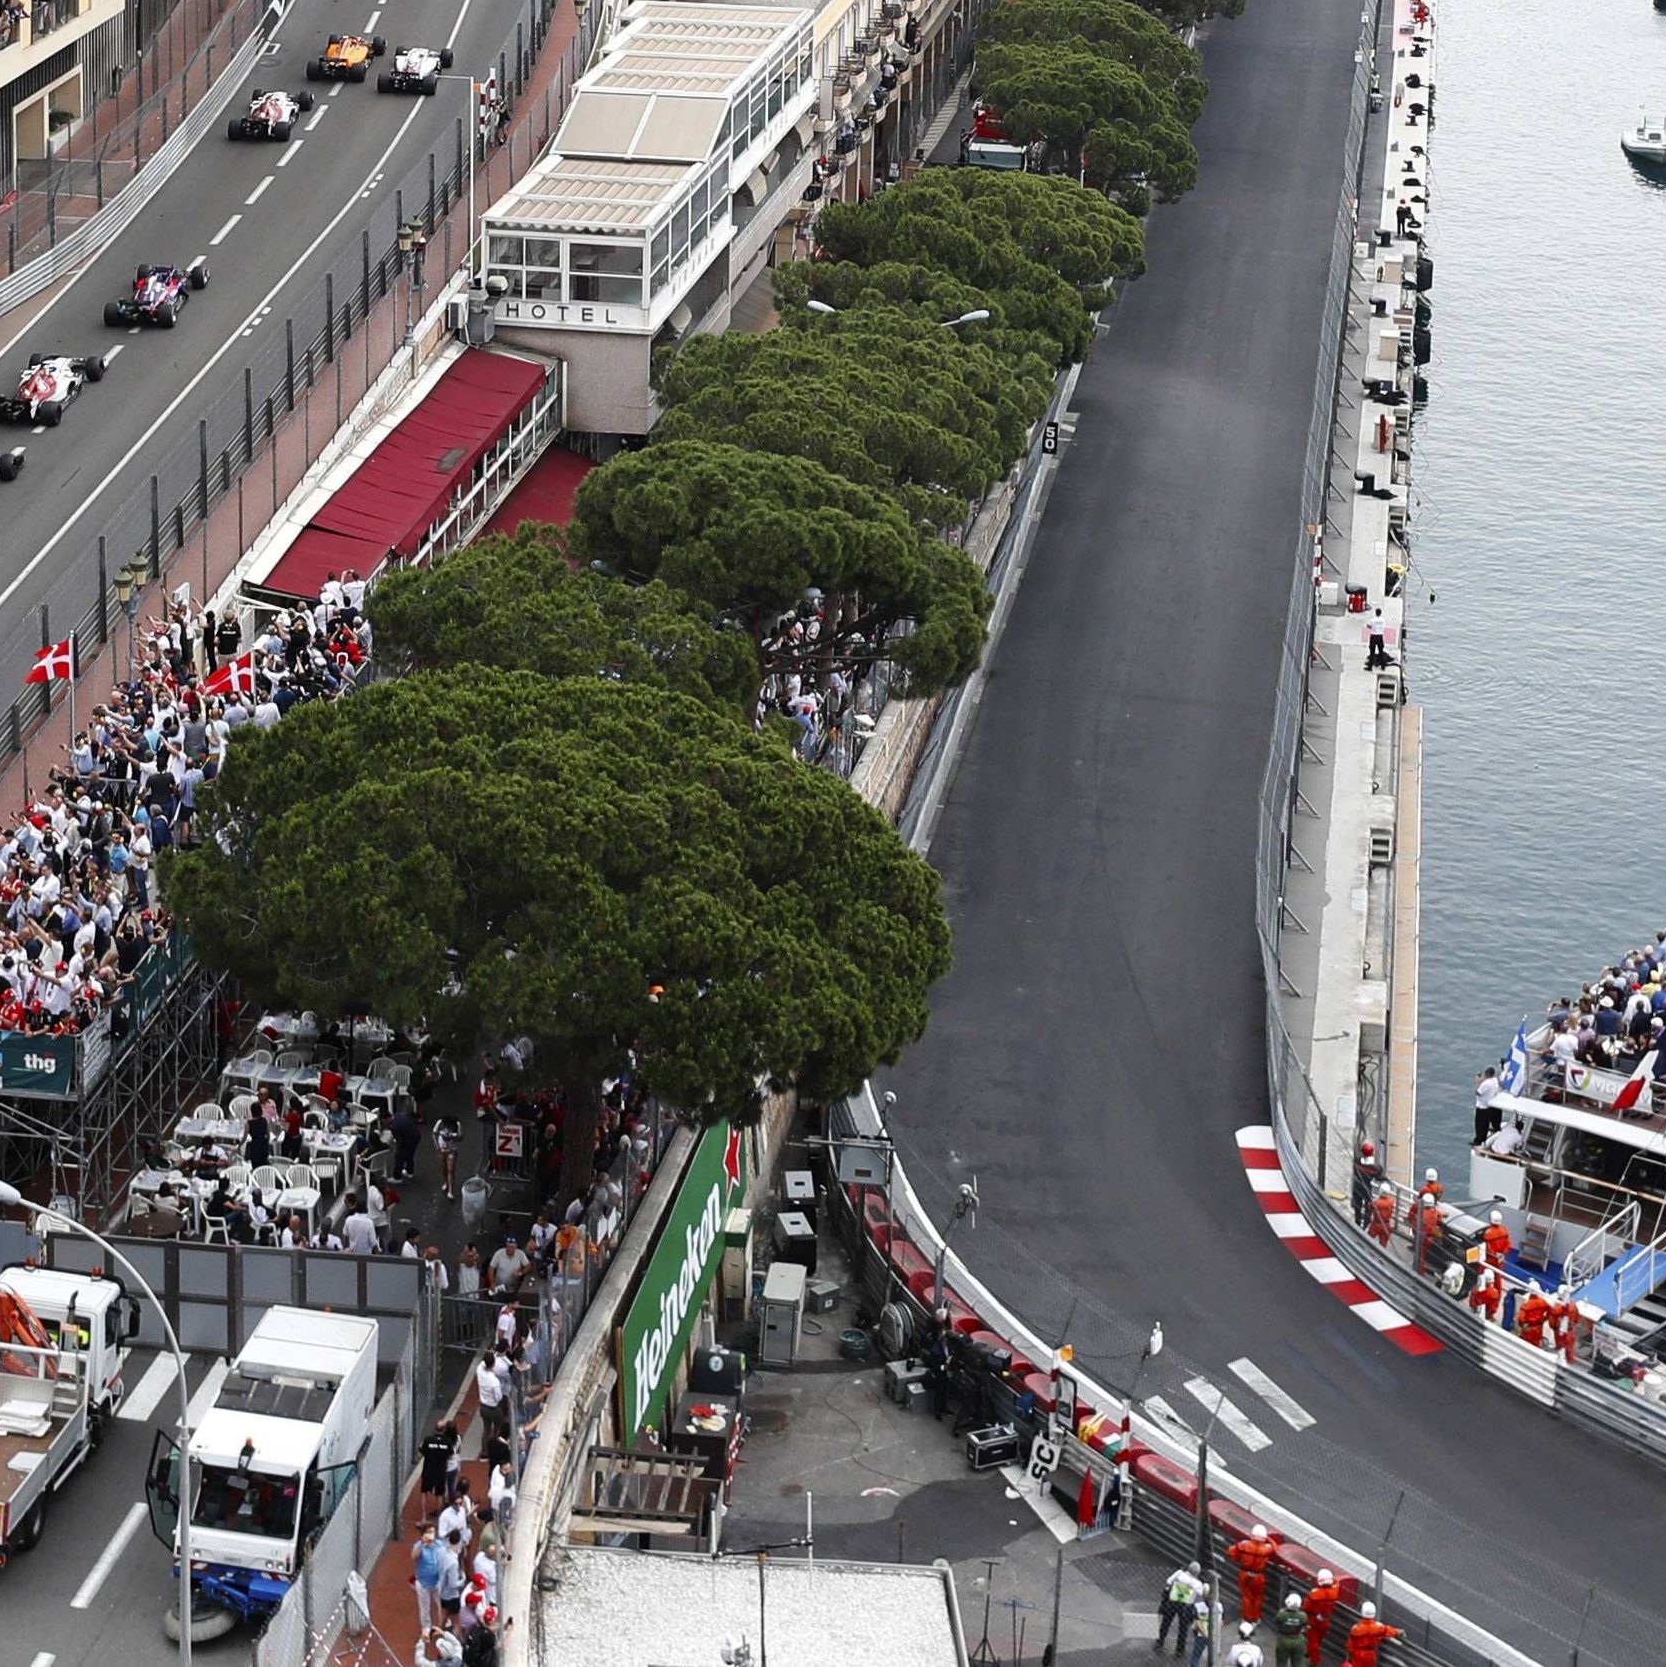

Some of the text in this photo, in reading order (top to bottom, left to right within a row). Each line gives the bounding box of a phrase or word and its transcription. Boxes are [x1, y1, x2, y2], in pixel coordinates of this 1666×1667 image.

[505, 302, 618, 325] HOTEL
[23, 1051, 56, 1073] thg
[630, 1181, 719, 1433] Heineken
[1031, 1443, 1055, 1480] SC
